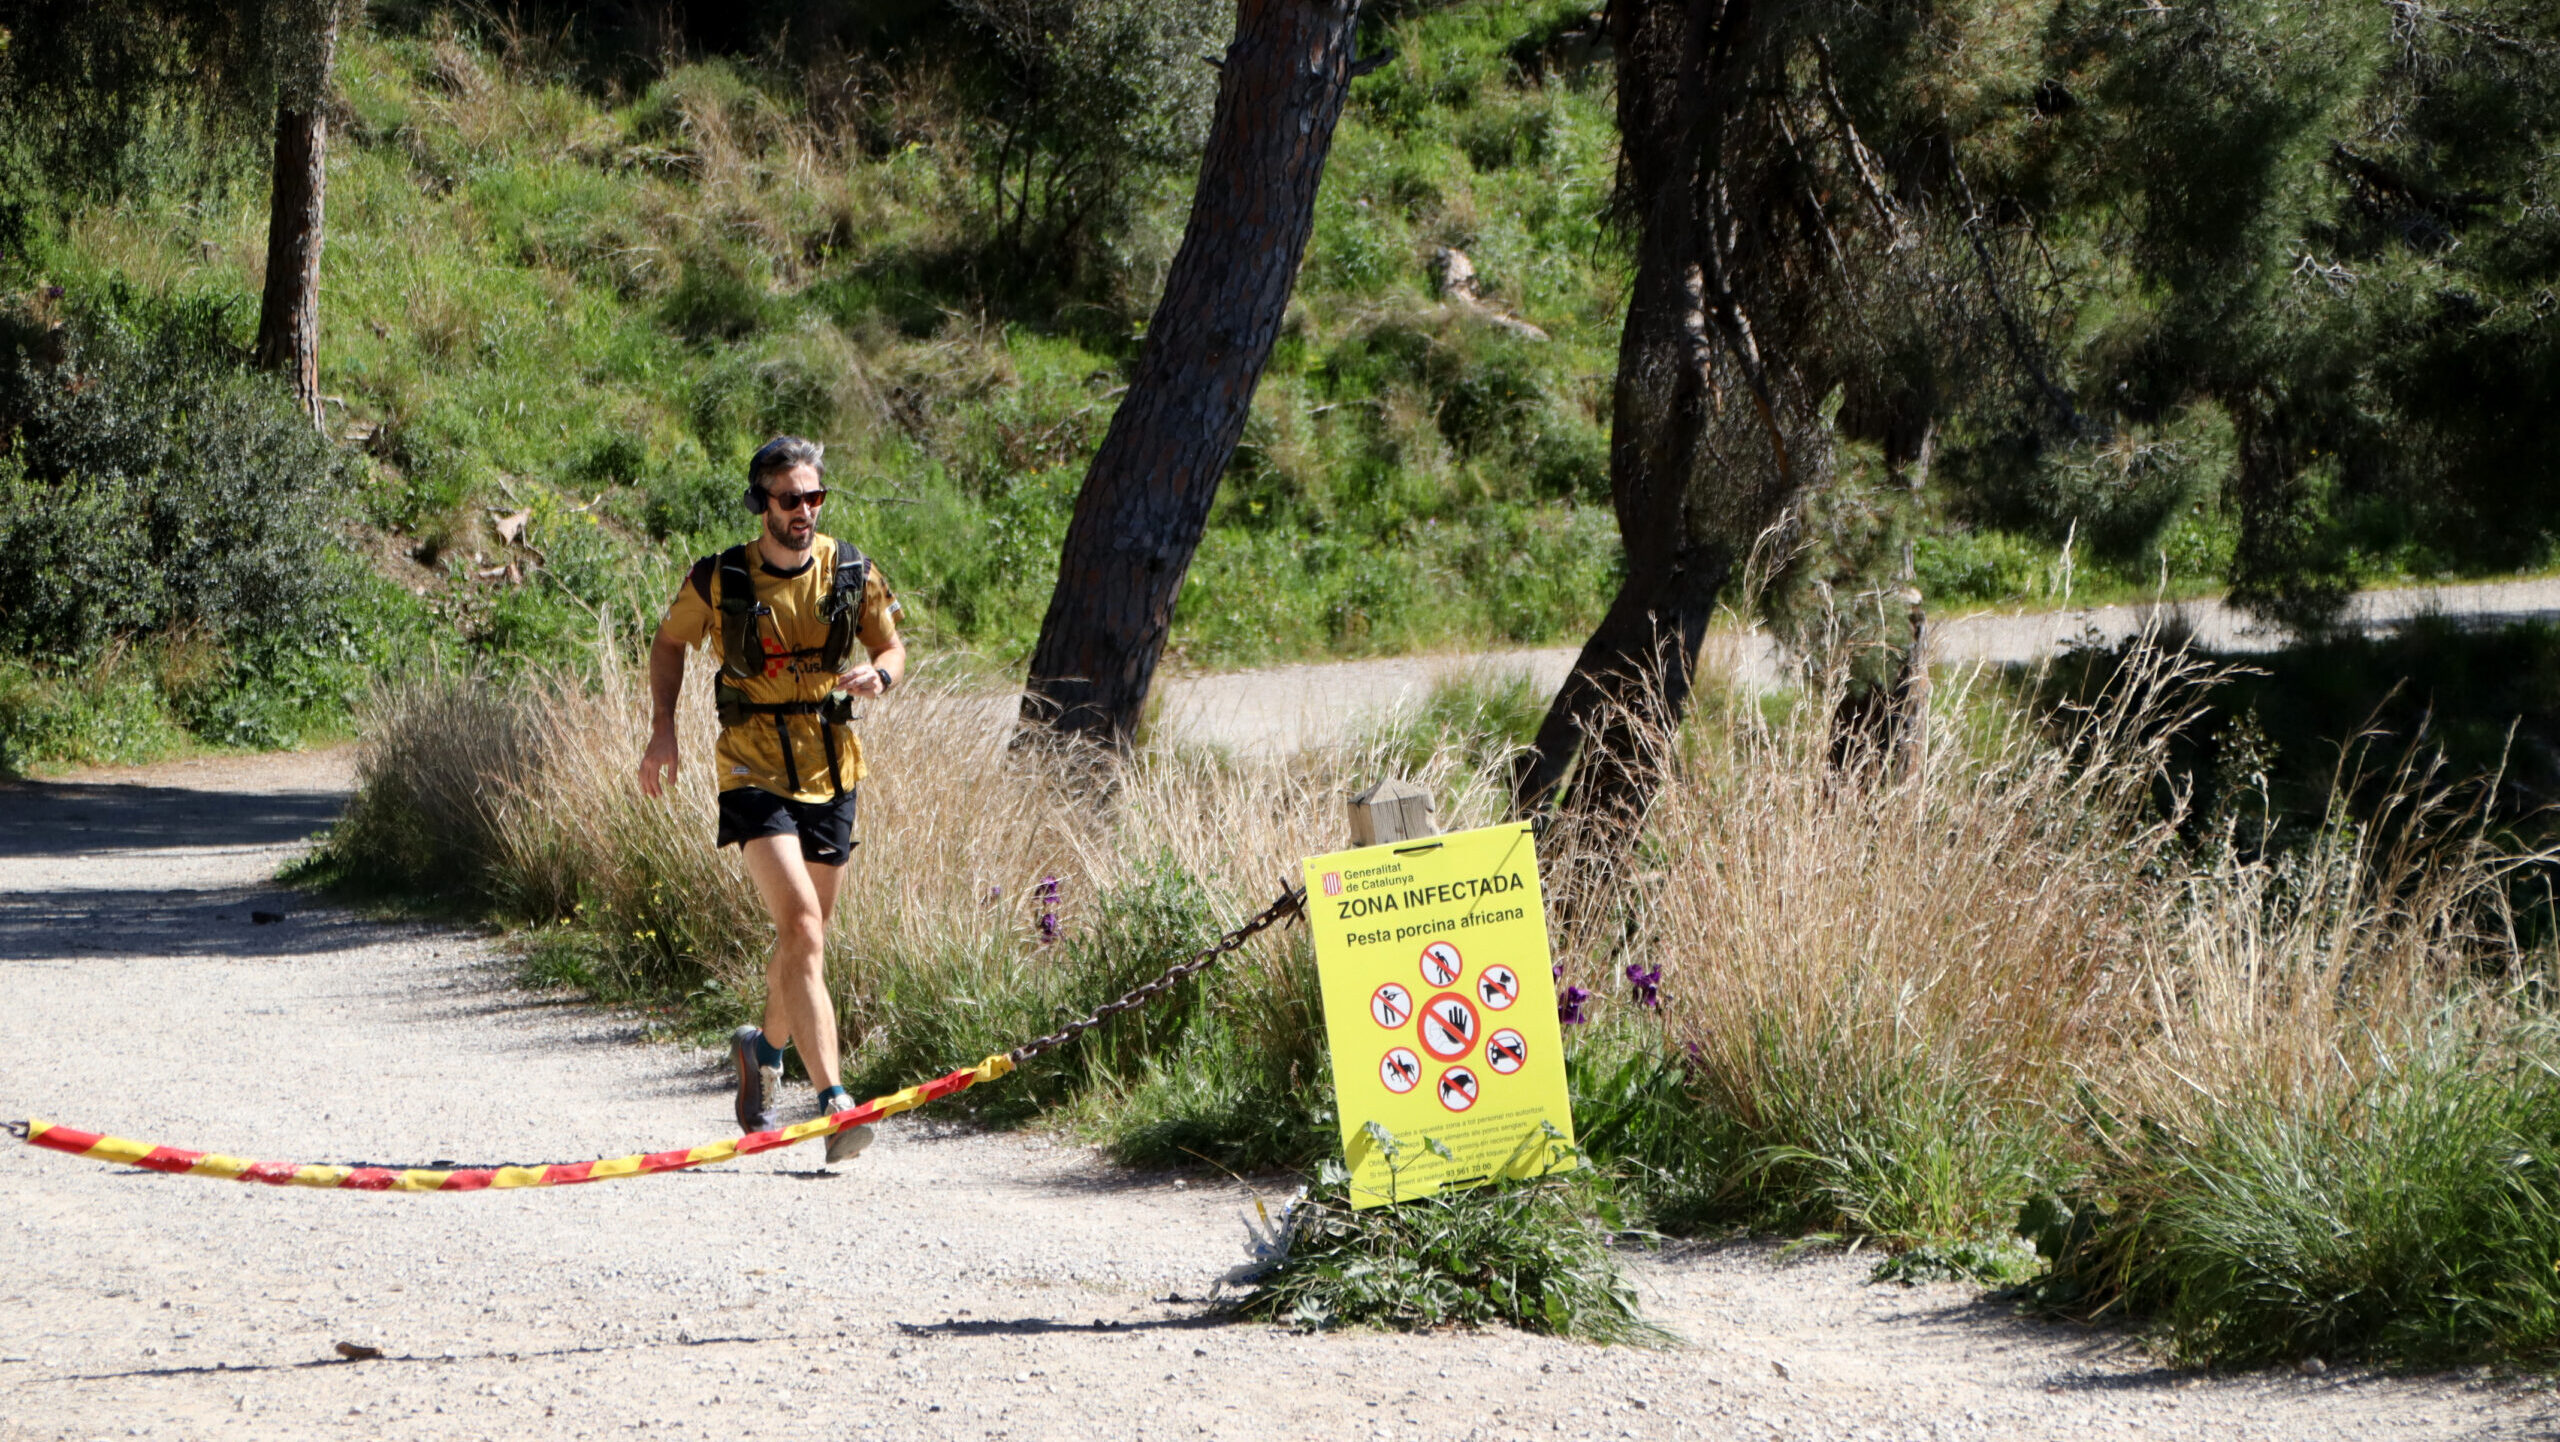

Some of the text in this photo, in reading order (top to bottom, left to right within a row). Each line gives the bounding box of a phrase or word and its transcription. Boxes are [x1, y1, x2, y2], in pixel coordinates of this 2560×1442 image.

[1344, 862, 1402, 880] Generalitat
[1345, 873, 1414, 893] de Catalunya
[1337, 872, 1524, 920] ZONA INFECTADA
[1347, 907, 1524, 948] Pesta porcina africana
